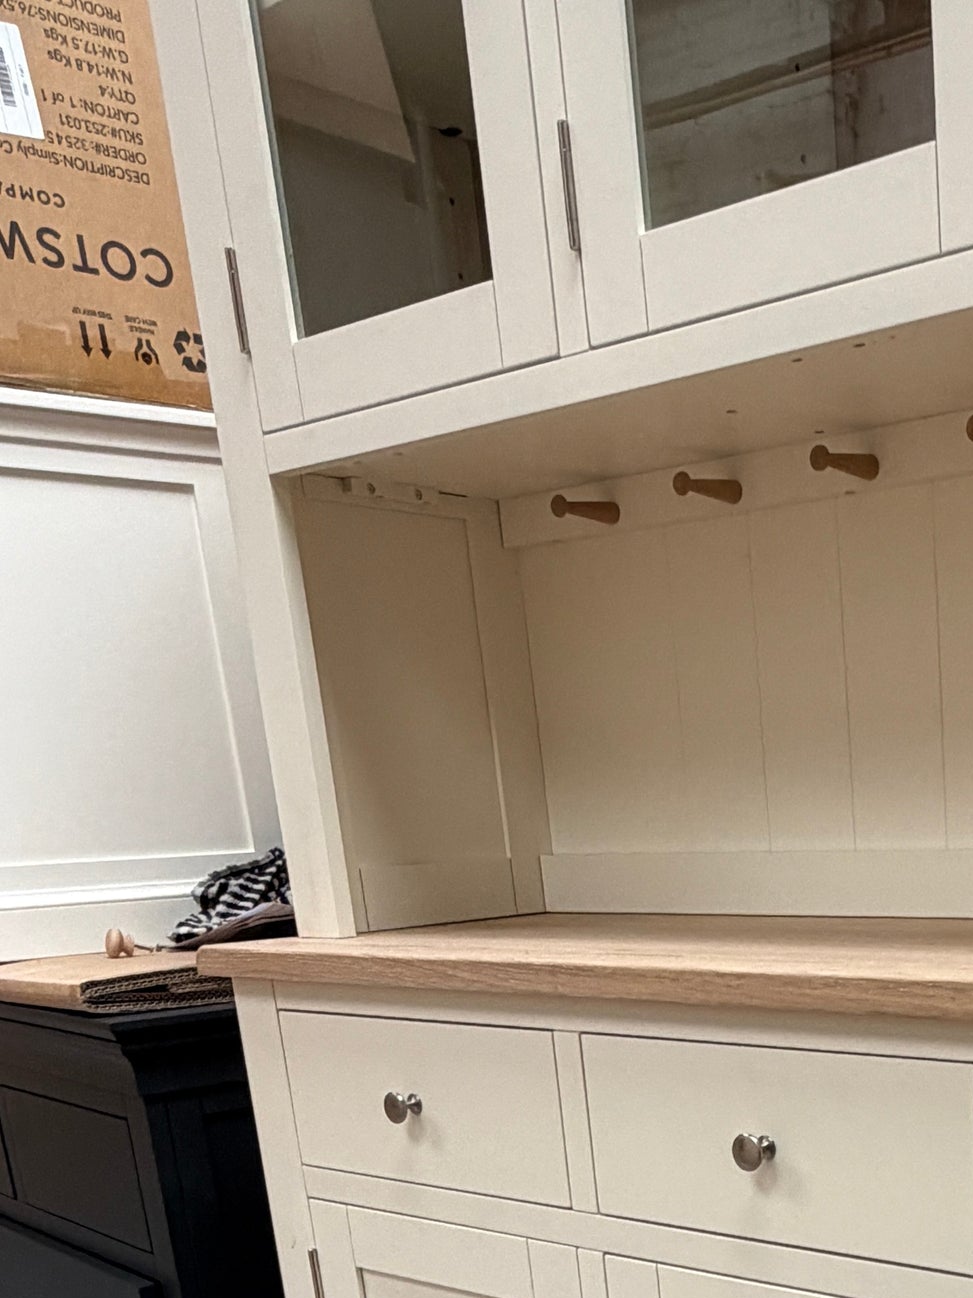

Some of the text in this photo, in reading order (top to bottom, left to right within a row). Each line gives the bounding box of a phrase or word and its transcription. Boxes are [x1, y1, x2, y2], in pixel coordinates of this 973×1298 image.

[43, 27, 68, 48] Kgs
[47, 48, 72, 68] Kgs
[41, 88, 140, 125] CARTON: 1 of 1
[0, 220, 173, 288] COTSW
